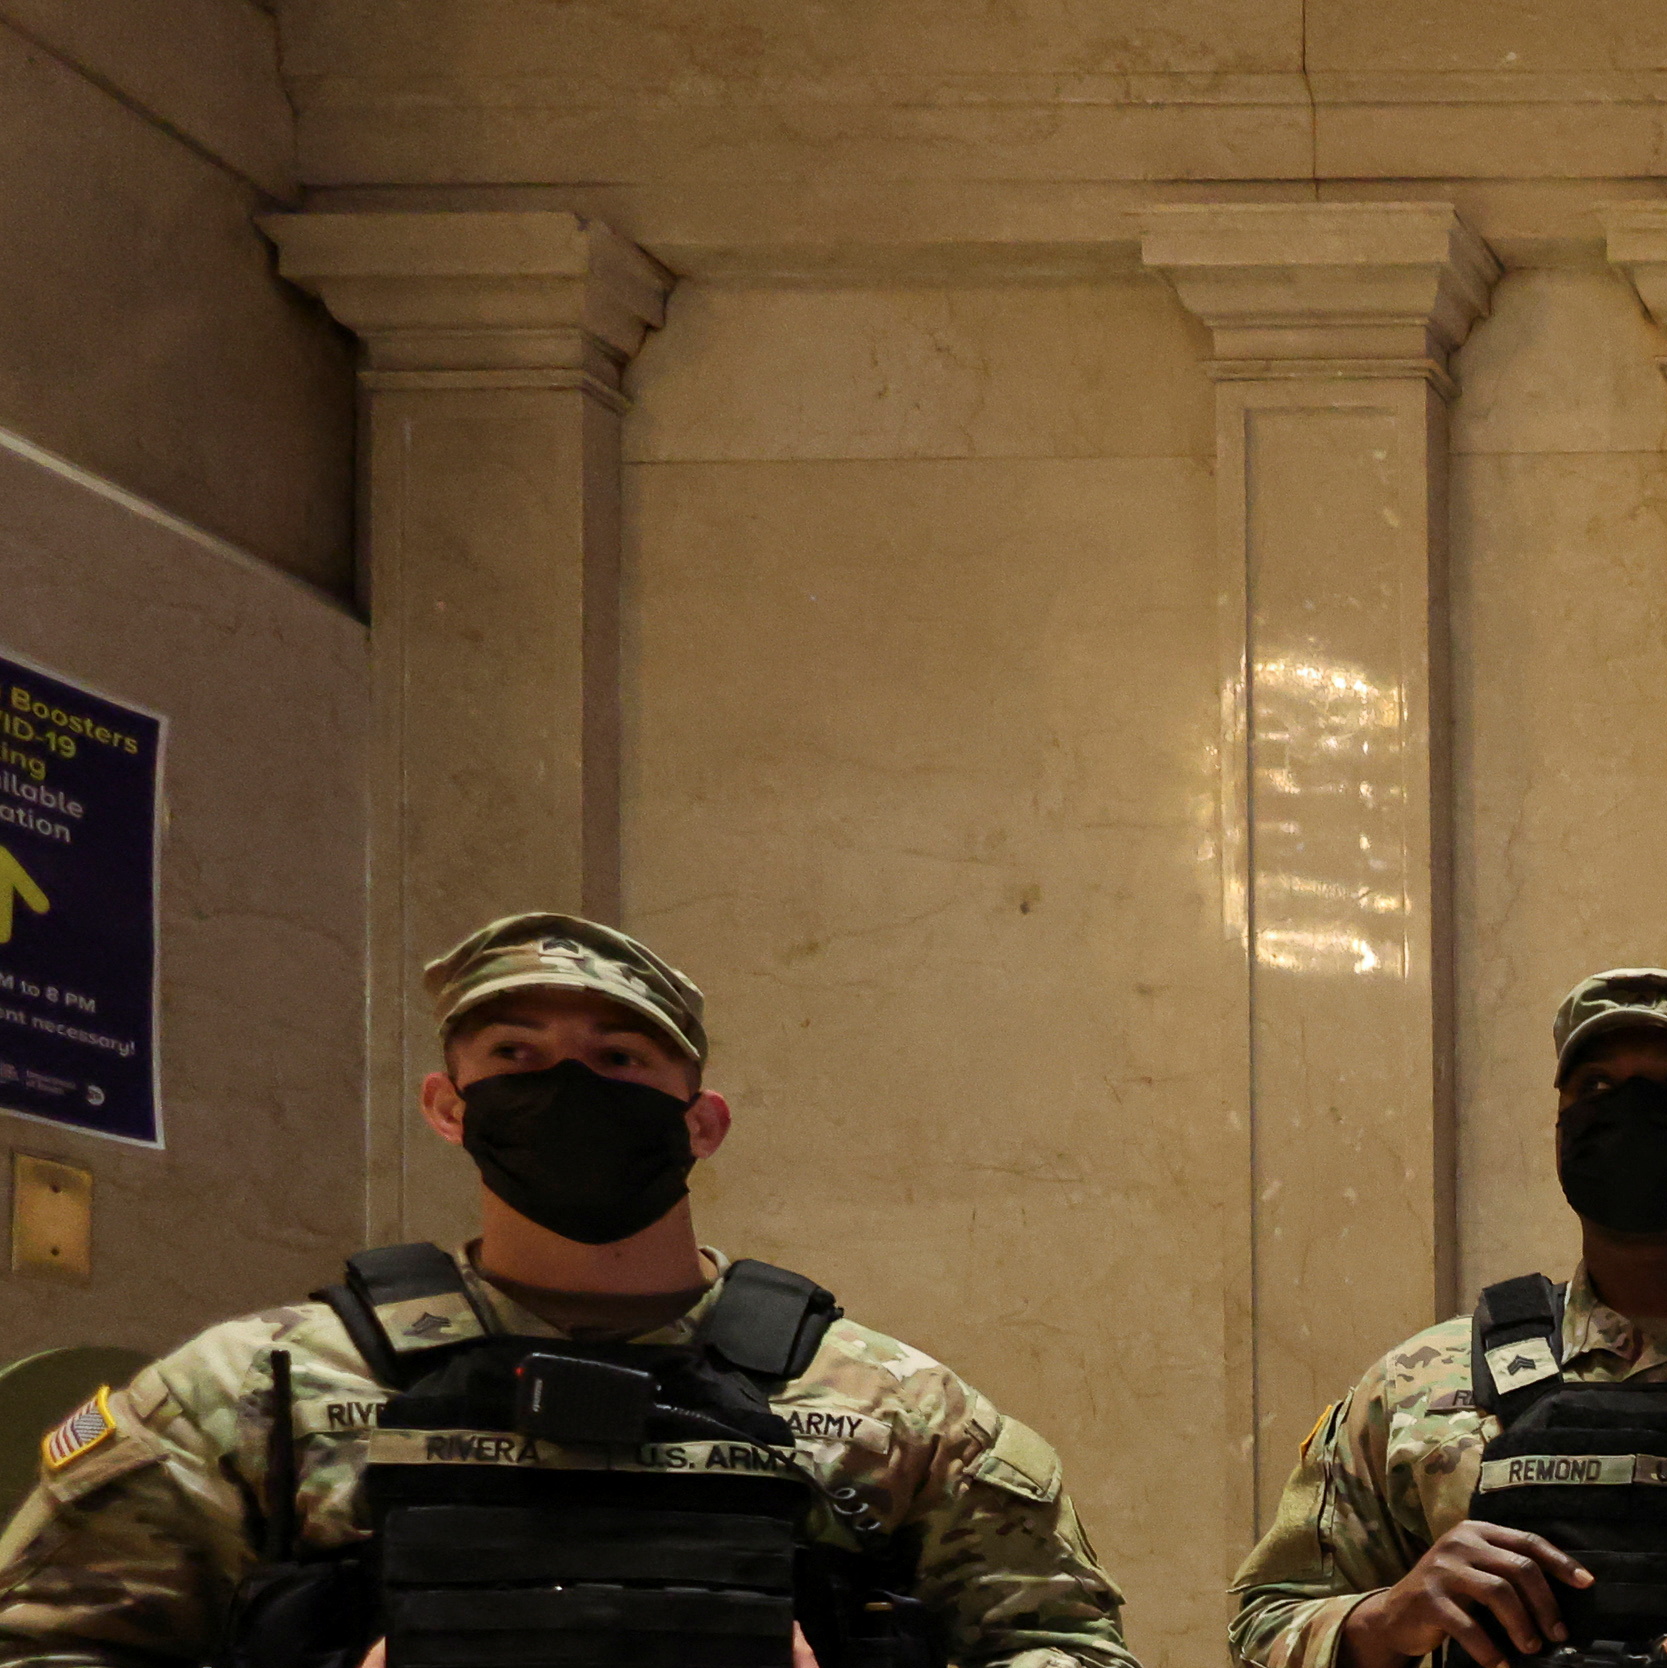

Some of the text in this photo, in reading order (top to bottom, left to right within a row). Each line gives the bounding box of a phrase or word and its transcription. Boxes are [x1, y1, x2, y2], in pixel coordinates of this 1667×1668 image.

[0, 708, 77, 759] ID-19
[10, 686, 139, 755] Boosters
[21, 980, 41, 998] to
[65, 991, 96, 1014] PM
[31, 1015, 136, 1058] necessary!
[426, 1435, 541, 1463] RIVERA
[1508, 1459, 1602, 1483] REMOND
